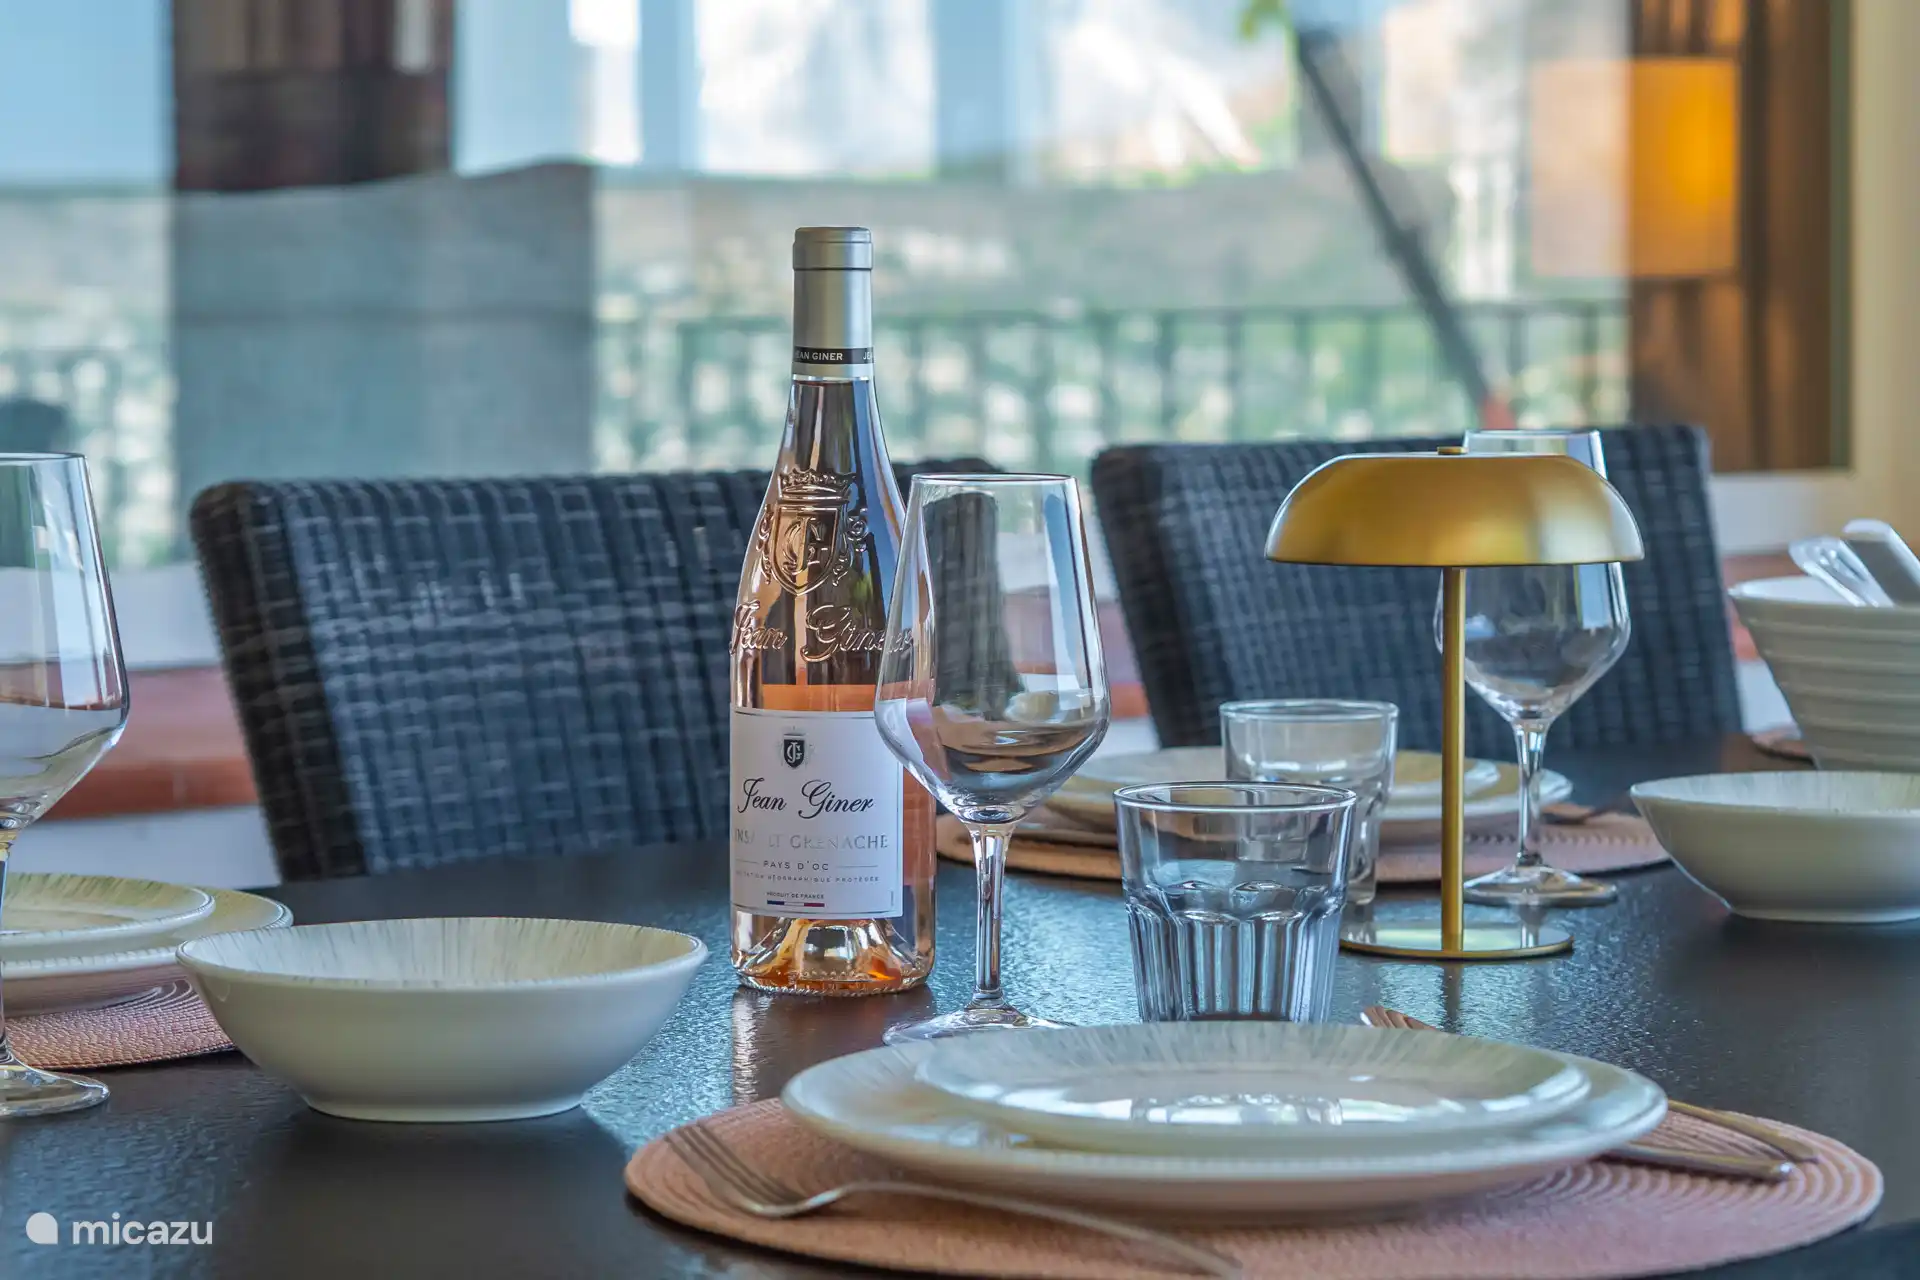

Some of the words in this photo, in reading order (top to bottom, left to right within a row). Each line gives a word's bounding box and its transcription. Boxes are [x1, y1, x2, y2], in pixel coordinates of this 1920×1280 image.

[795, 350, 810, 360] EAN
[812, 352, 843, 361] GINER
[730, 600, 788, 656] Jean
[737, 777, 787, 814] Jean
[798, 779, 874, 819] Giner
[790, 834, 889, 850] GRENACHE
[763, 860, 791, 870] PAYS
[797, 860, 829, 871] D'OC
